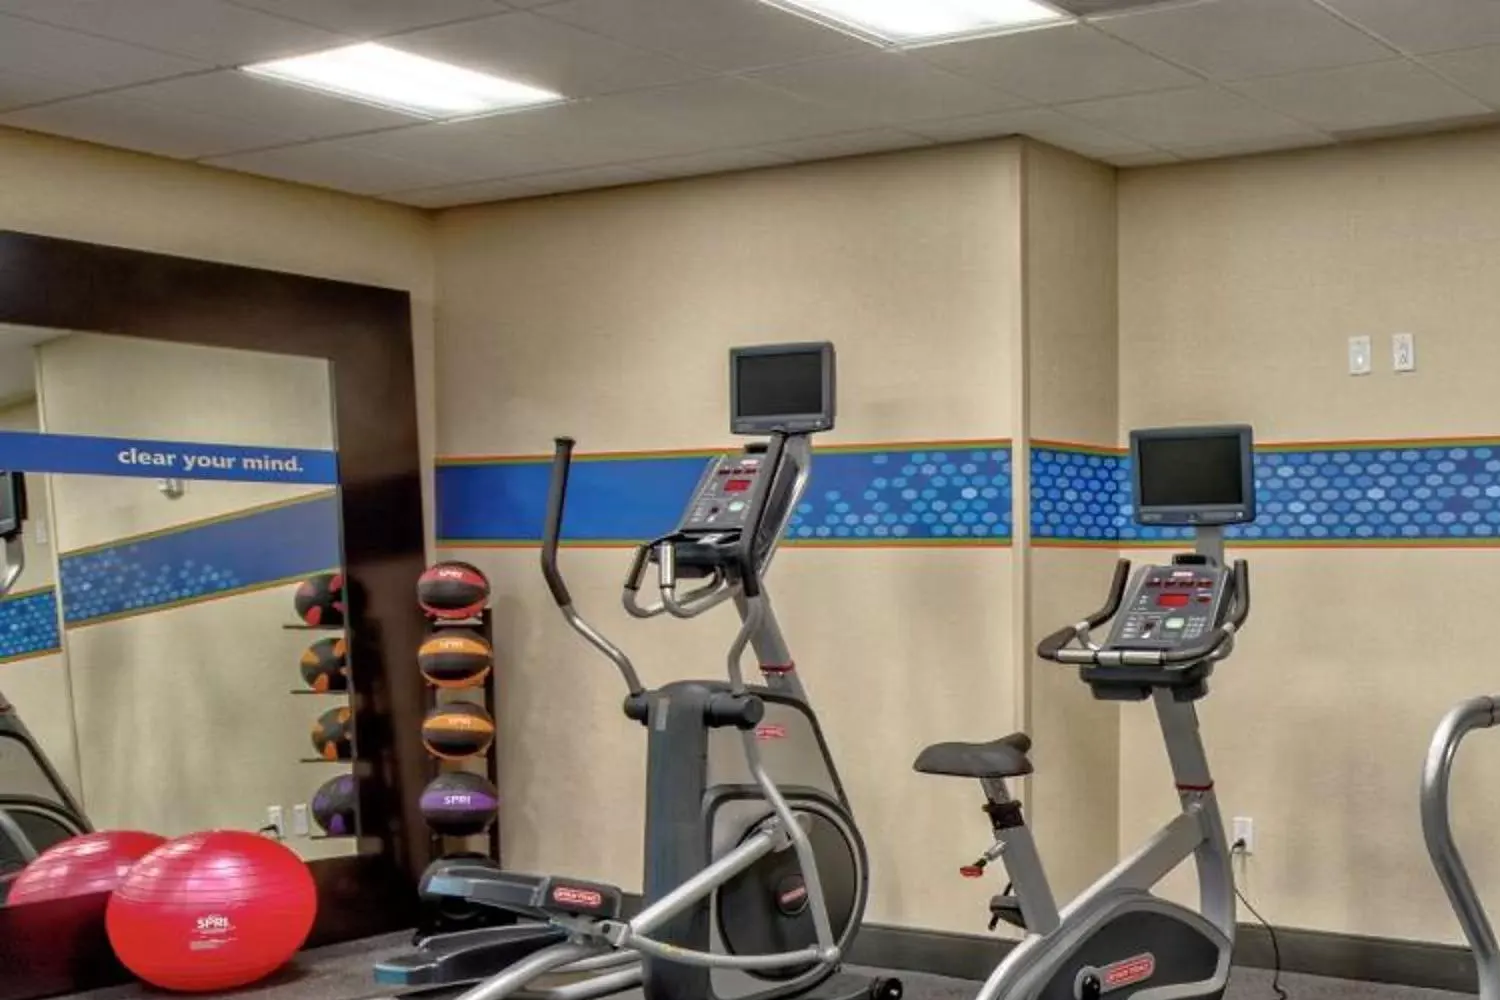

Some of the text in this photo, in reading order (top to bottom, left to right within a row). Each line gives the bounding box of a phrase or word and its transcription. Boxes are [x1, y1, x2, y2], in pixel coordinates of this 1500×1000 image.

[117, 447, 304, 472] clear your mind.
